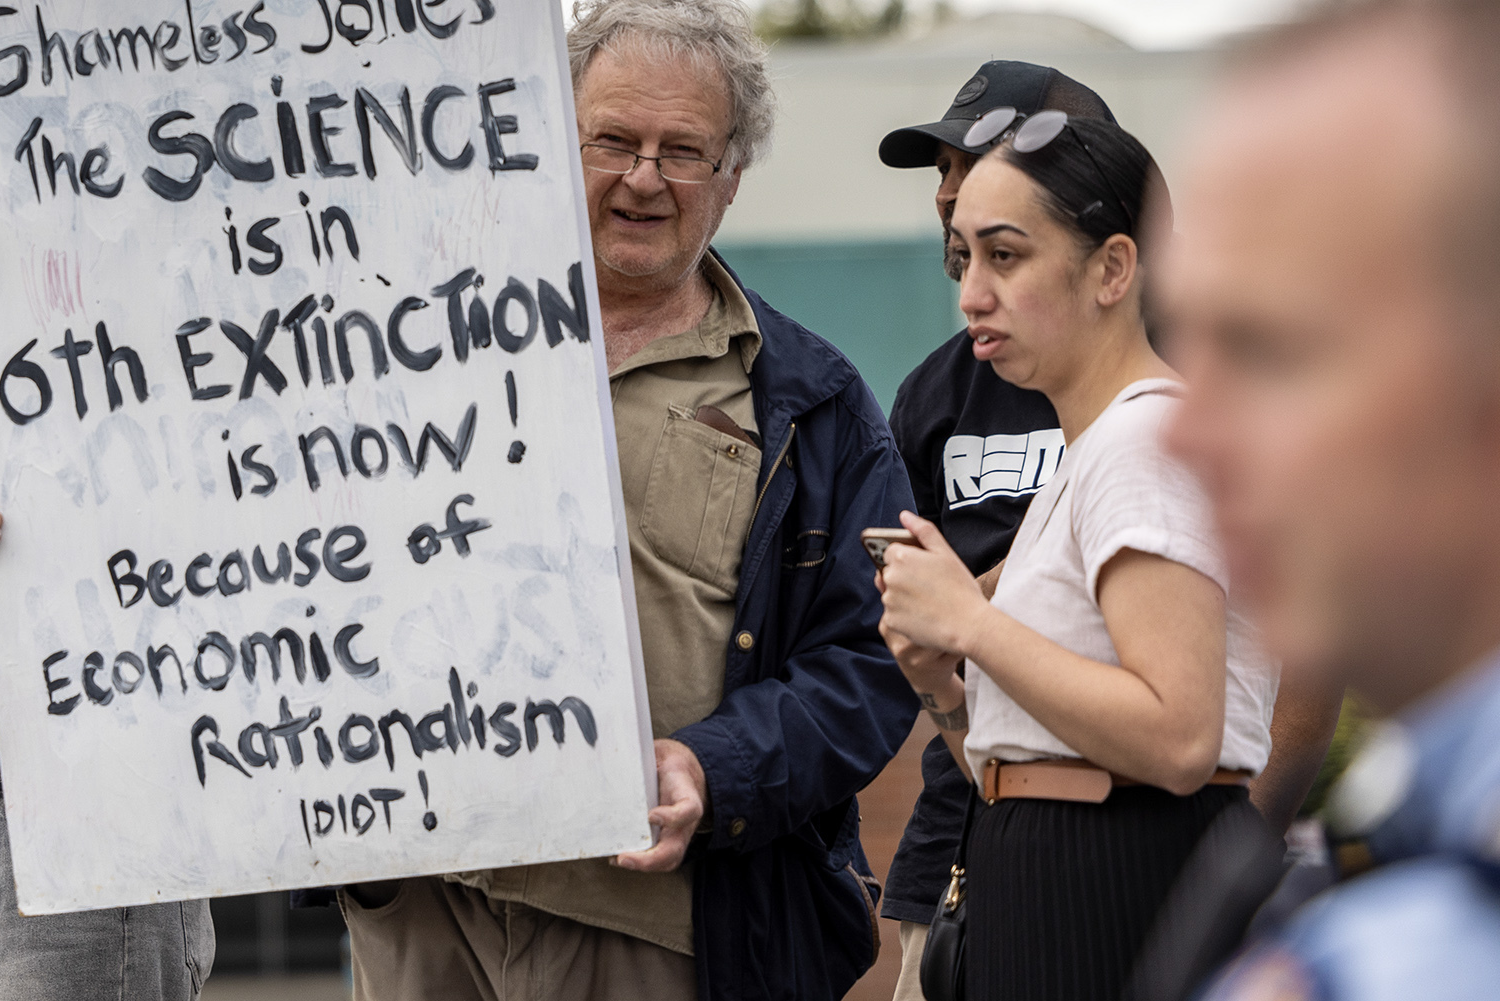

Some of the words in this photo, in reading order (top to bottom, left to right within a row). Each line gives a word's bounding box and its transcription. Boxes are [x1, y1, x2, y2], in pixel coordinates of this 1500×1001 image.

[14, 116, 126, 204] The
[222, 206, 284, 276] is
[298, 190, 361, 265] in
[221, 429, 279, 502] is
[107, 524, 372, 609] Because
[405, 493, 492, 565] of
[42, 605, 381, 716] Economic
[190, 666, 598, 788] Rationalism
